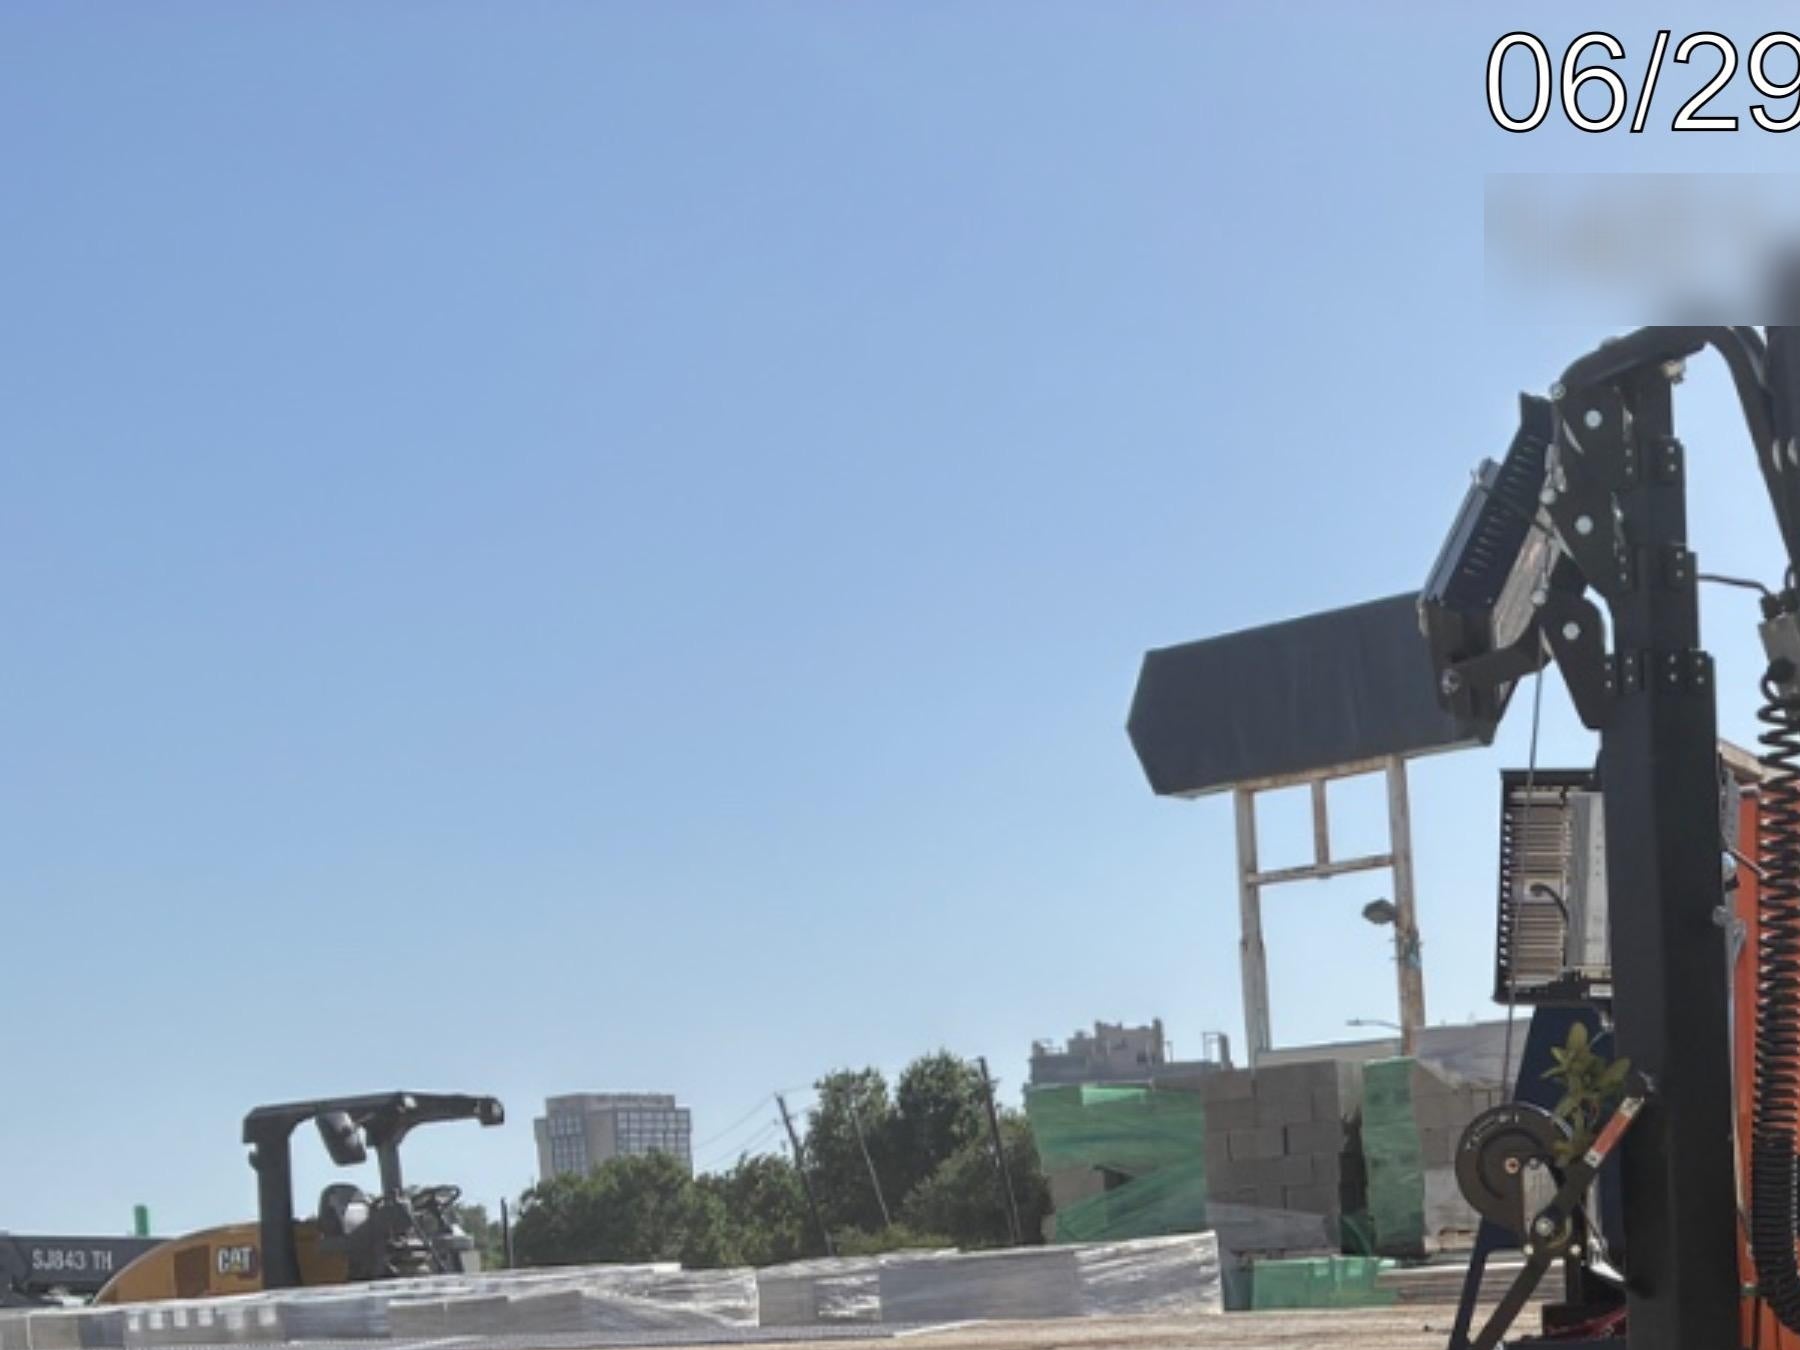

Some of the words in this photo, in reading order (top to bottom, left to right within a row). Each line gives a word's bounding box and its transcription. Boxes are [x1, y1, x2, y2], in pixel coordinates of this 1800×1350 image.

[31, 1249, 86, 1271] SJ843
[92, 1250, 113, 1272] TH
[217, 1246, 252, 1275] CAT
